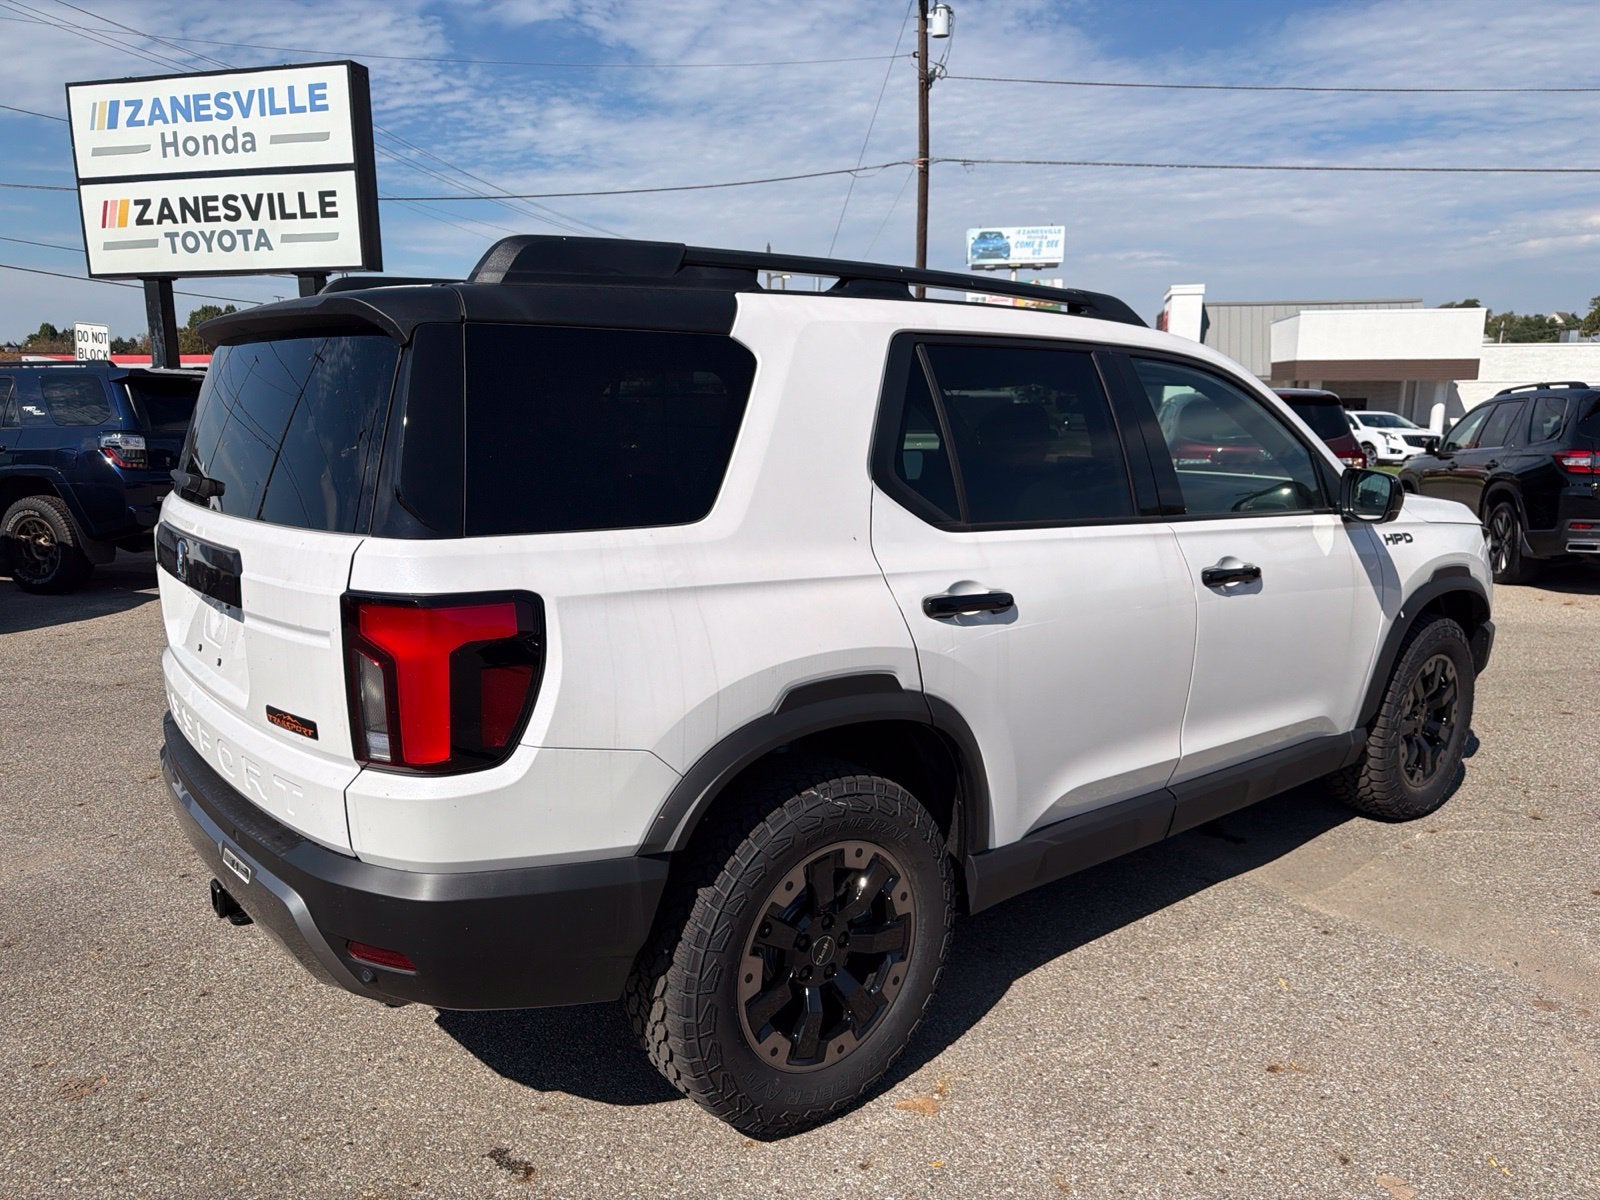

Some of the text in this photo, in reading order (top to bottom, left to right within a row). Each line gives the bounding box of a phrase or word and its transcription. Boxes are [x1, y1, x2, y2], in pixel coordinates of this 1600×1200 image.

[124, 82, 329, 128] ZANESVILLE
[160, 126, 256, 158] Honda
[133, 190, 338, 226] ZANESVILLE
[164, 228, 273, 254] TOYOTA
[1015, 240, 1035, 249] COME
[1046, 239, 1059, 248] SEE
[77, 330, 107, 344] DO NOT
[78, 347, 108, 360] BLOCK
[1382, 532, 1413, 545] HPD
